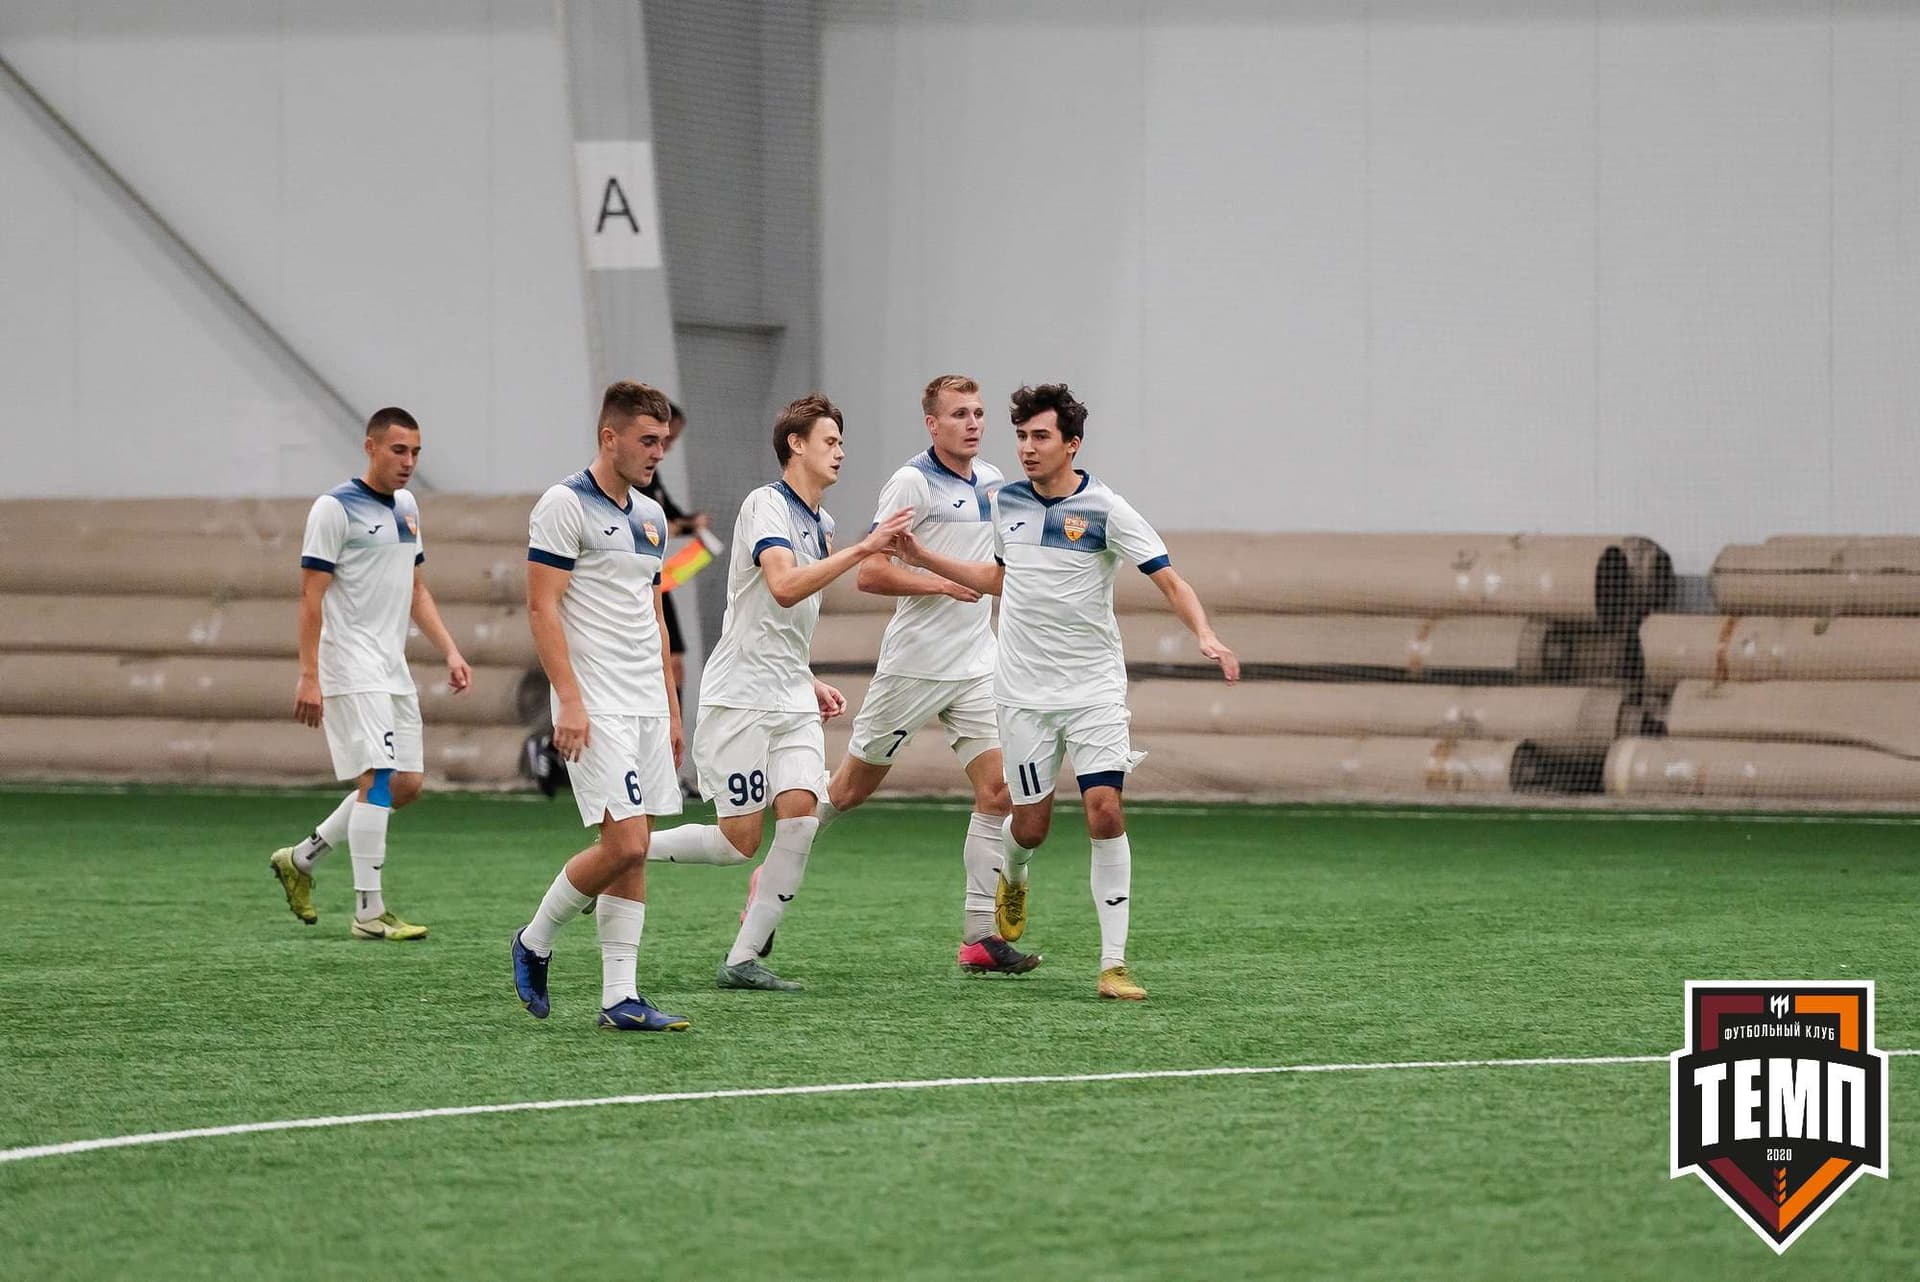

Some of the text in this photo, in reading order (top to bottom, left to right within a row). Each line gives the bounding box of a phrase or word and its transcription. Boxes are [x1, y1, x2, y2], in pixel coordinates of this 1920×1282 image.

[597, 178, 639, 233] A
[886, 730, 907, 757] 7
[625, 770, 642, 805] 6
[728, 769, 764, 806] 98
[1019, 762, 1041, 796] 11
